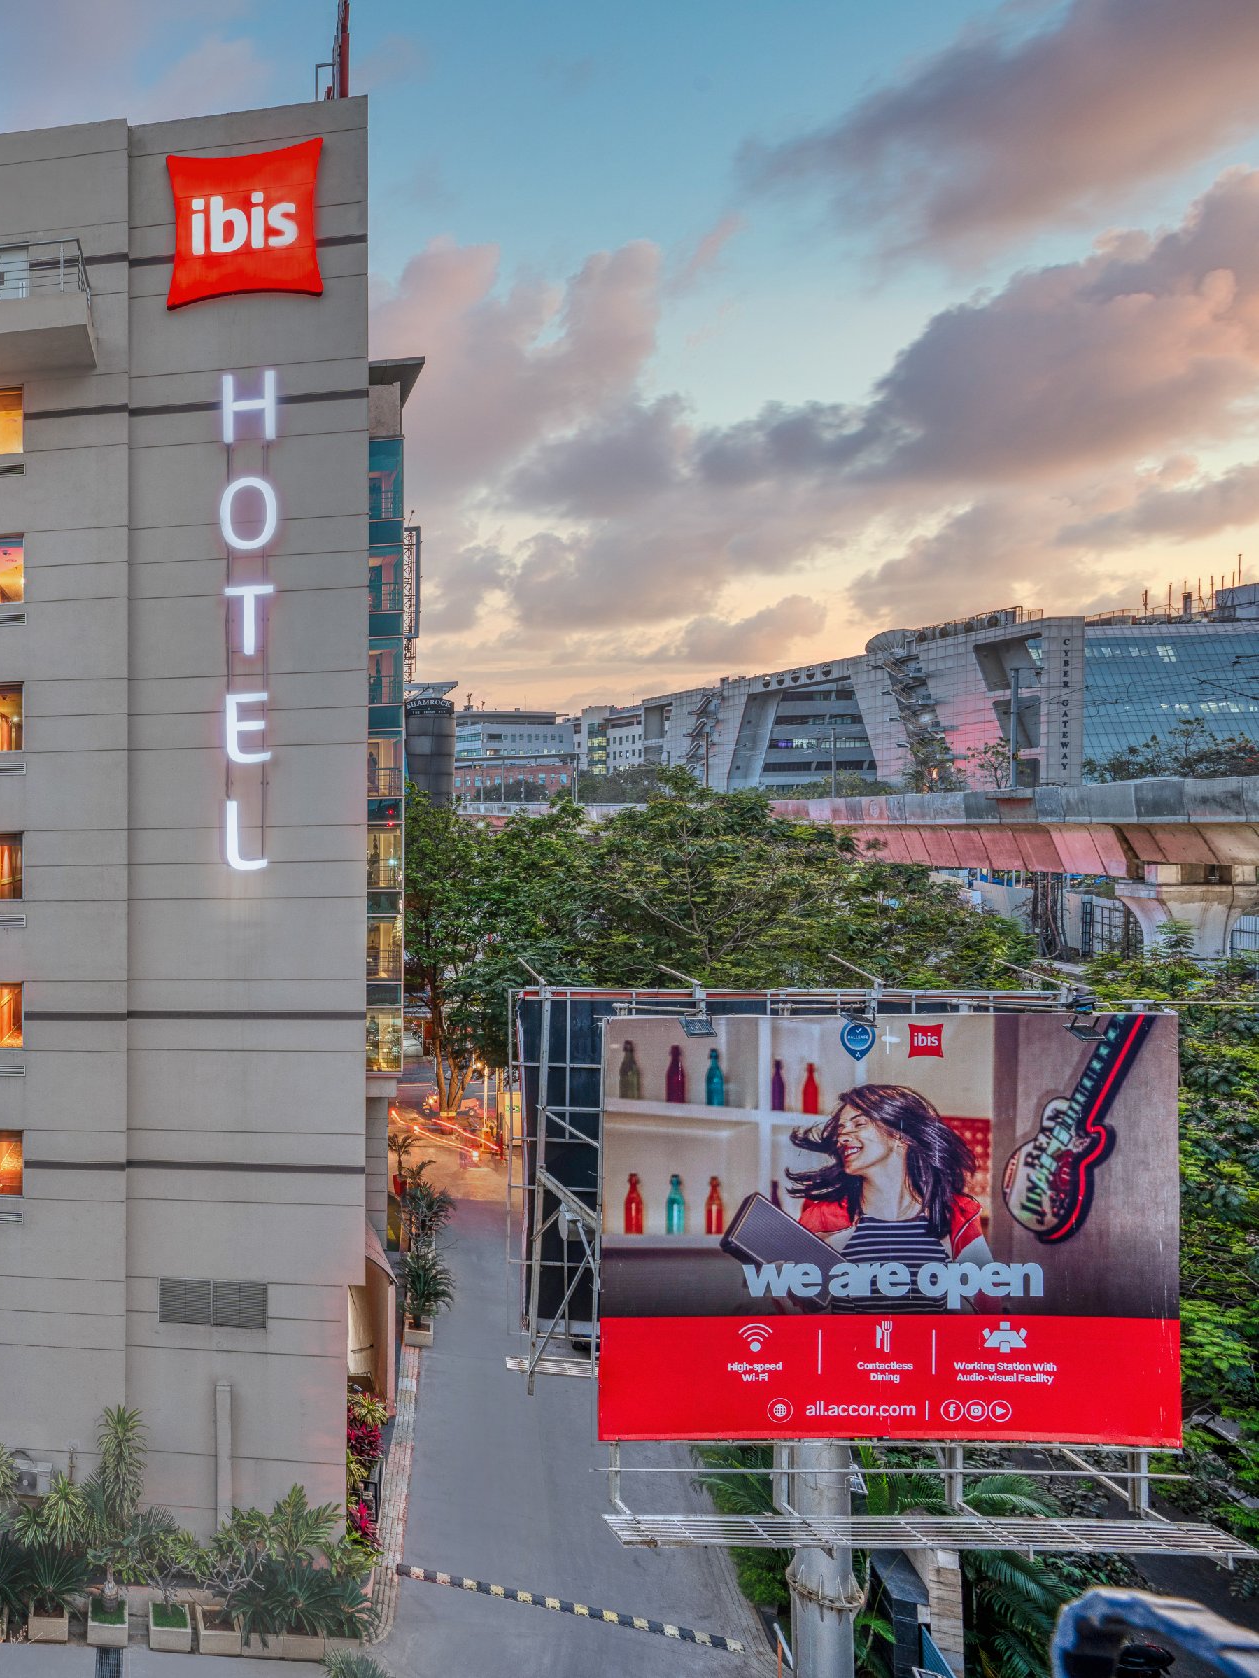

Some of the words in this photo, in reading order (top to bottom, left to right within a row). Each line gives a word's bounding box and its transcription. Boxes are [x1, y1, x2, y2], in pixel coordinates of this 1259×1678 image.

[191, 191, 299, 256] ibis
[220, 369, 277, 870] HOTEL
[406, 699, 451, 710] SHAMROCK
[1060, 699, 1070, 770] GATEWAY
[913, 1032, 939, 1047] ibis
[741, 1262, 822, 1297] we
[828, 1262, 911, 1297] are
[917, 1262, 1044, 1310] open
[727, 1362, 783, 1373] High-speed
[857, 1361, 913, 1371] Contactless
[953, 1361, 996, 1373] Working
[997, 1362, 1031, 1371] Station
[1032, 1362, 1058, 1372] With
[742, 1373, 769, 1382] Wi-Fi
[870, 1372, 900, 1384] Dining
[956, 1373, 1017, 1382] Audio-visual
[1018, 1373, 1054, 1386] Facility
[805, 1400, 916, 1416] all.accor.com
